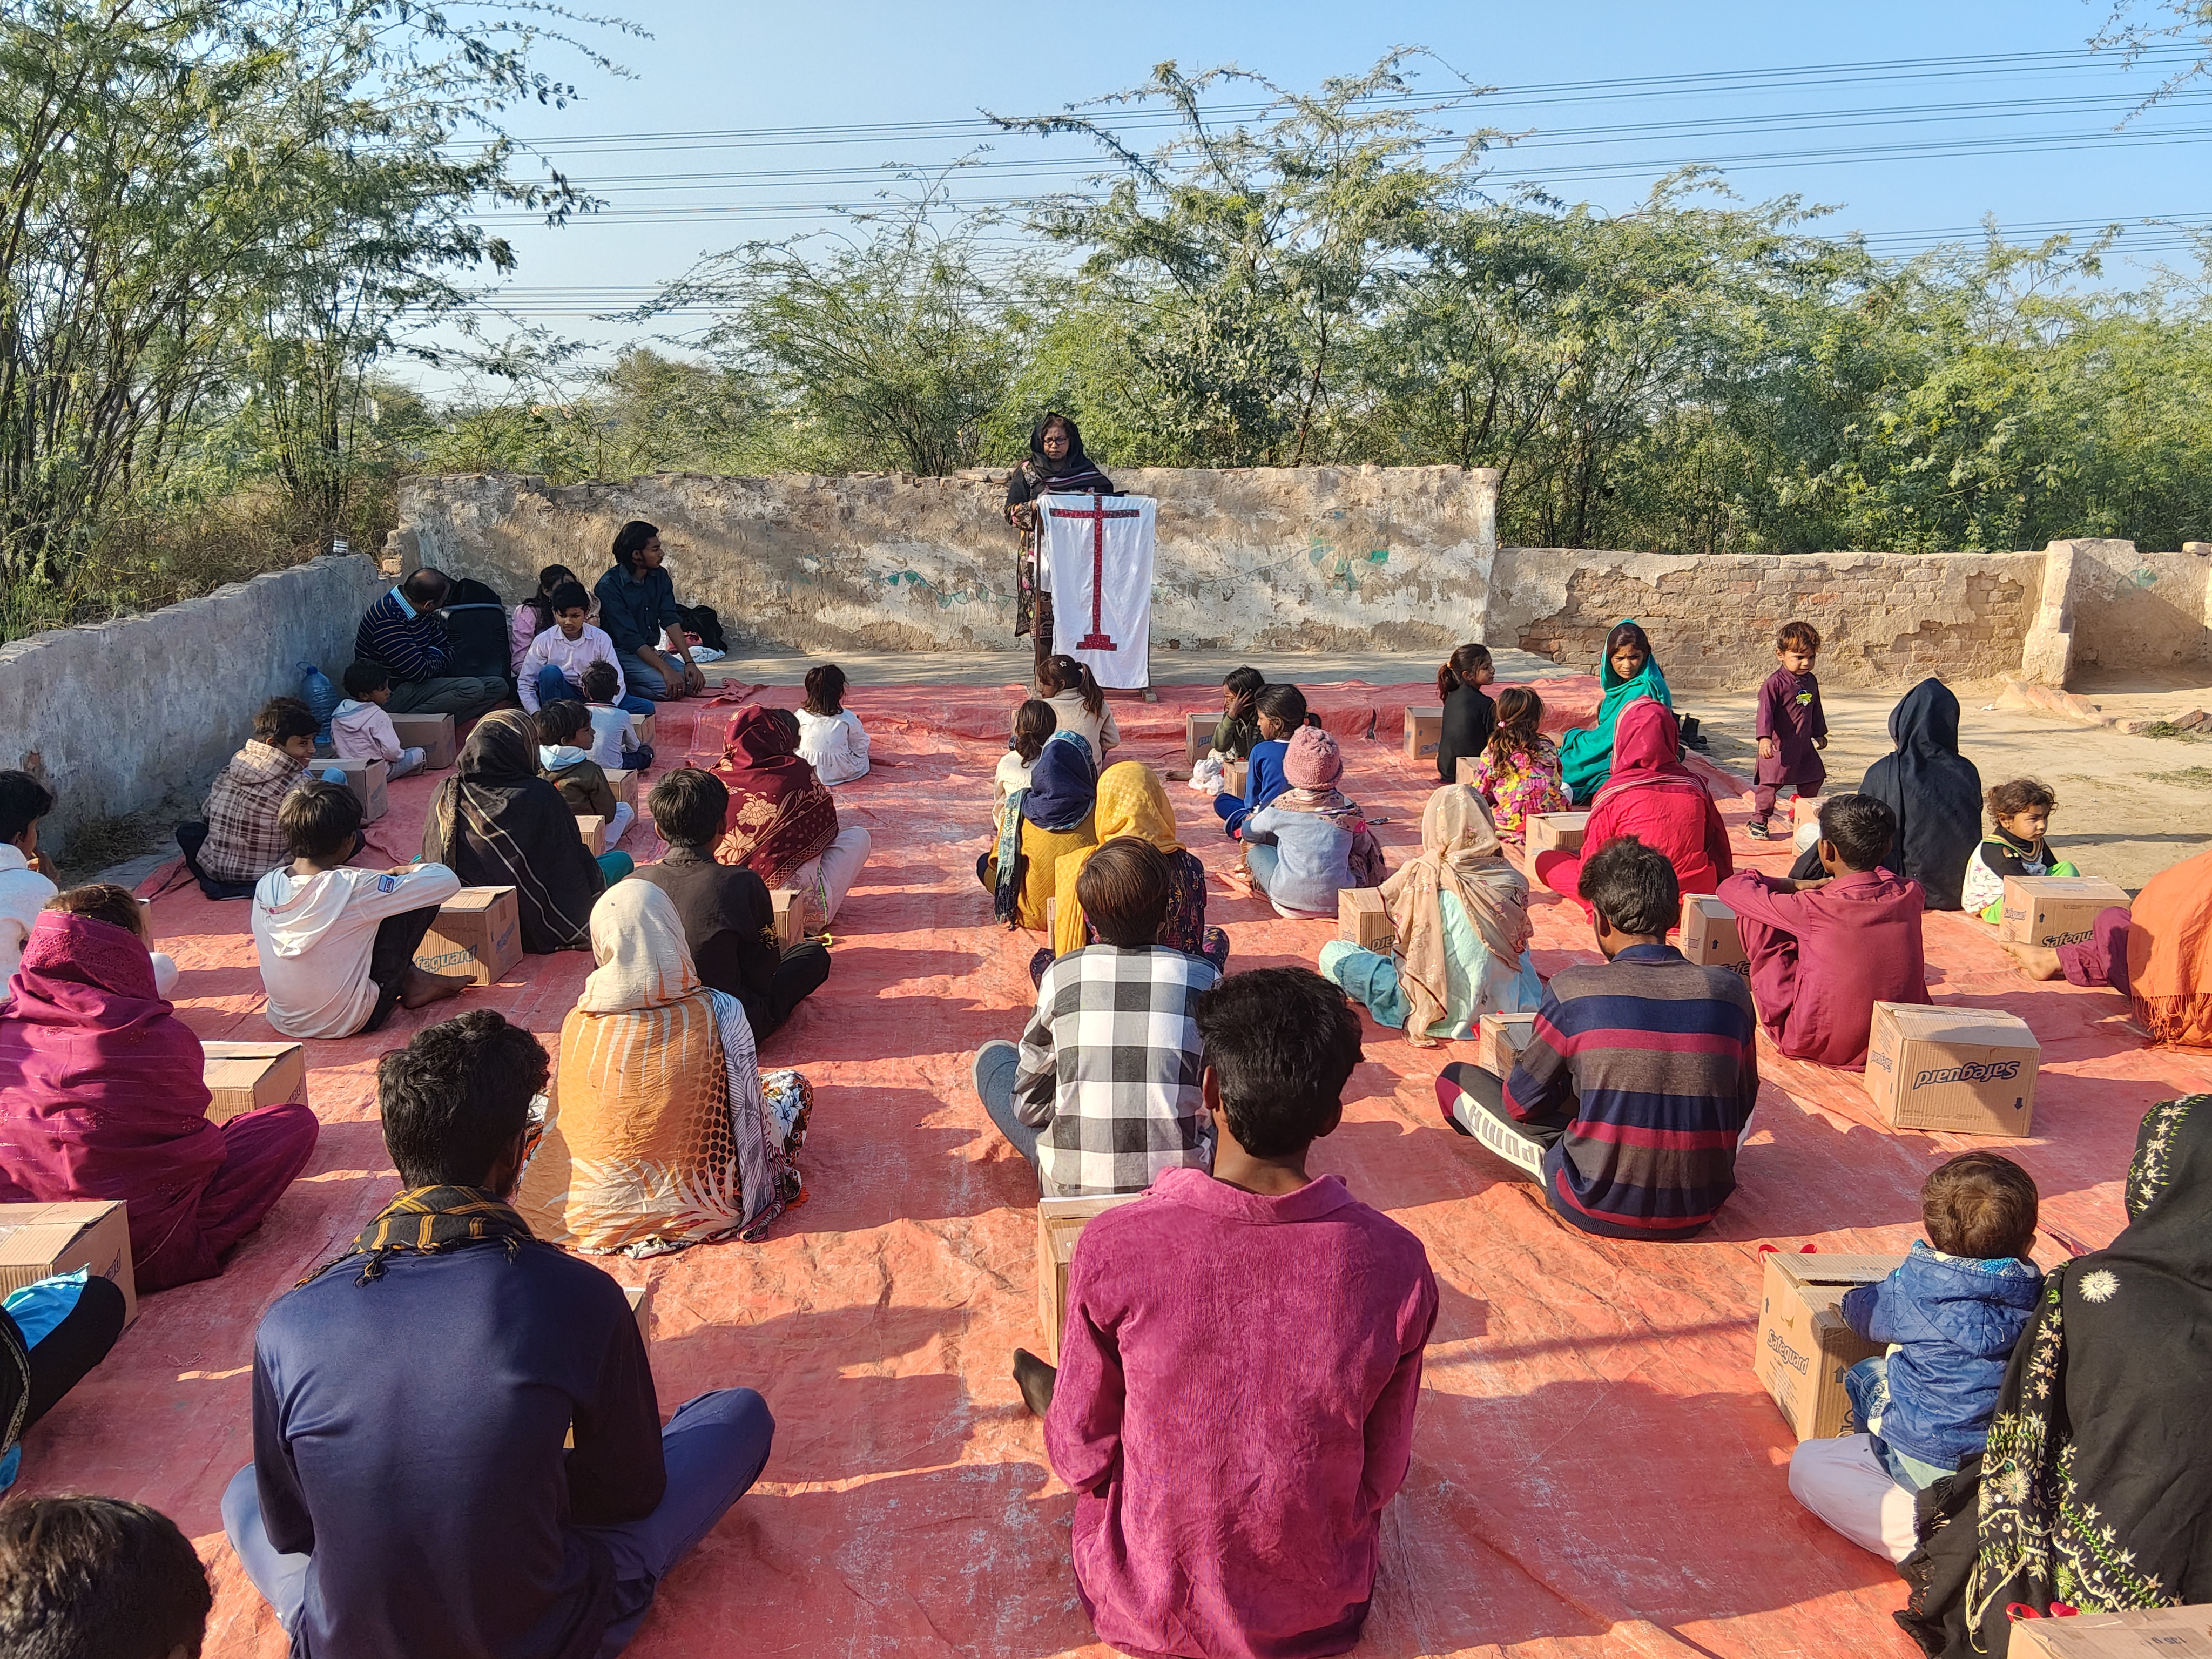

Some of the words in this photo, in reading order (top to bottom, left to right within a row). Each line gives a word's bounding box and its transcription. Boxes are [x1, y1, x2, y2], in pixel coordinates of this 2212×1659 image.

[1912, 1061, 2021, 1090] Safeguard
[1468, 1104, 1536, 1166] PUMA
[1766, 1328, 1809, 1375] Safeguard
